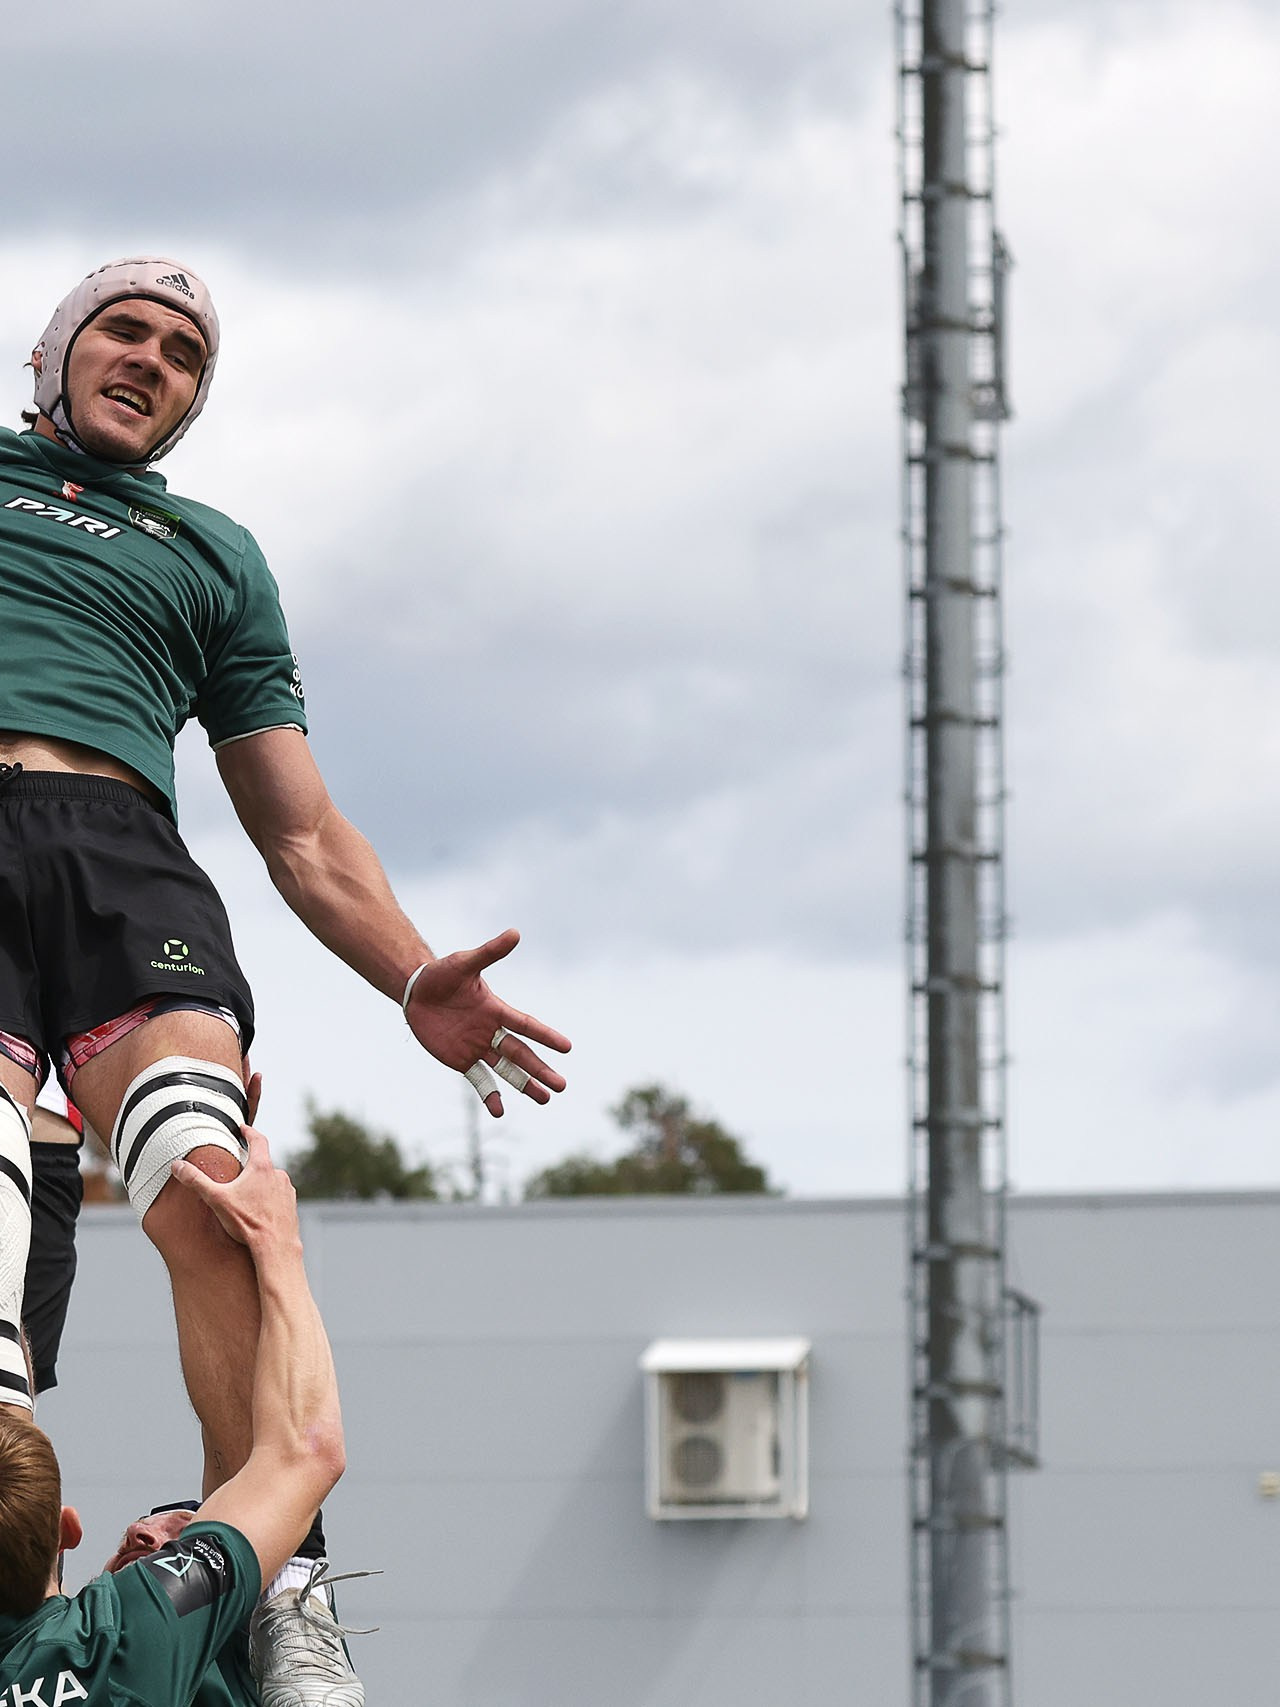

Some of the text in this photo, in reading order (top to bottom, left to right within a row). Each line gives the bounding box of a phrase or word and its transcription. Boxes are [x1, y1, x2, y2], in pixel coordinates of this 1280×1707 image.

[155, 278, 195, 300] adidas
[4, 496, 121, 539] PARI
[150, 960, 205, 976] centurion
